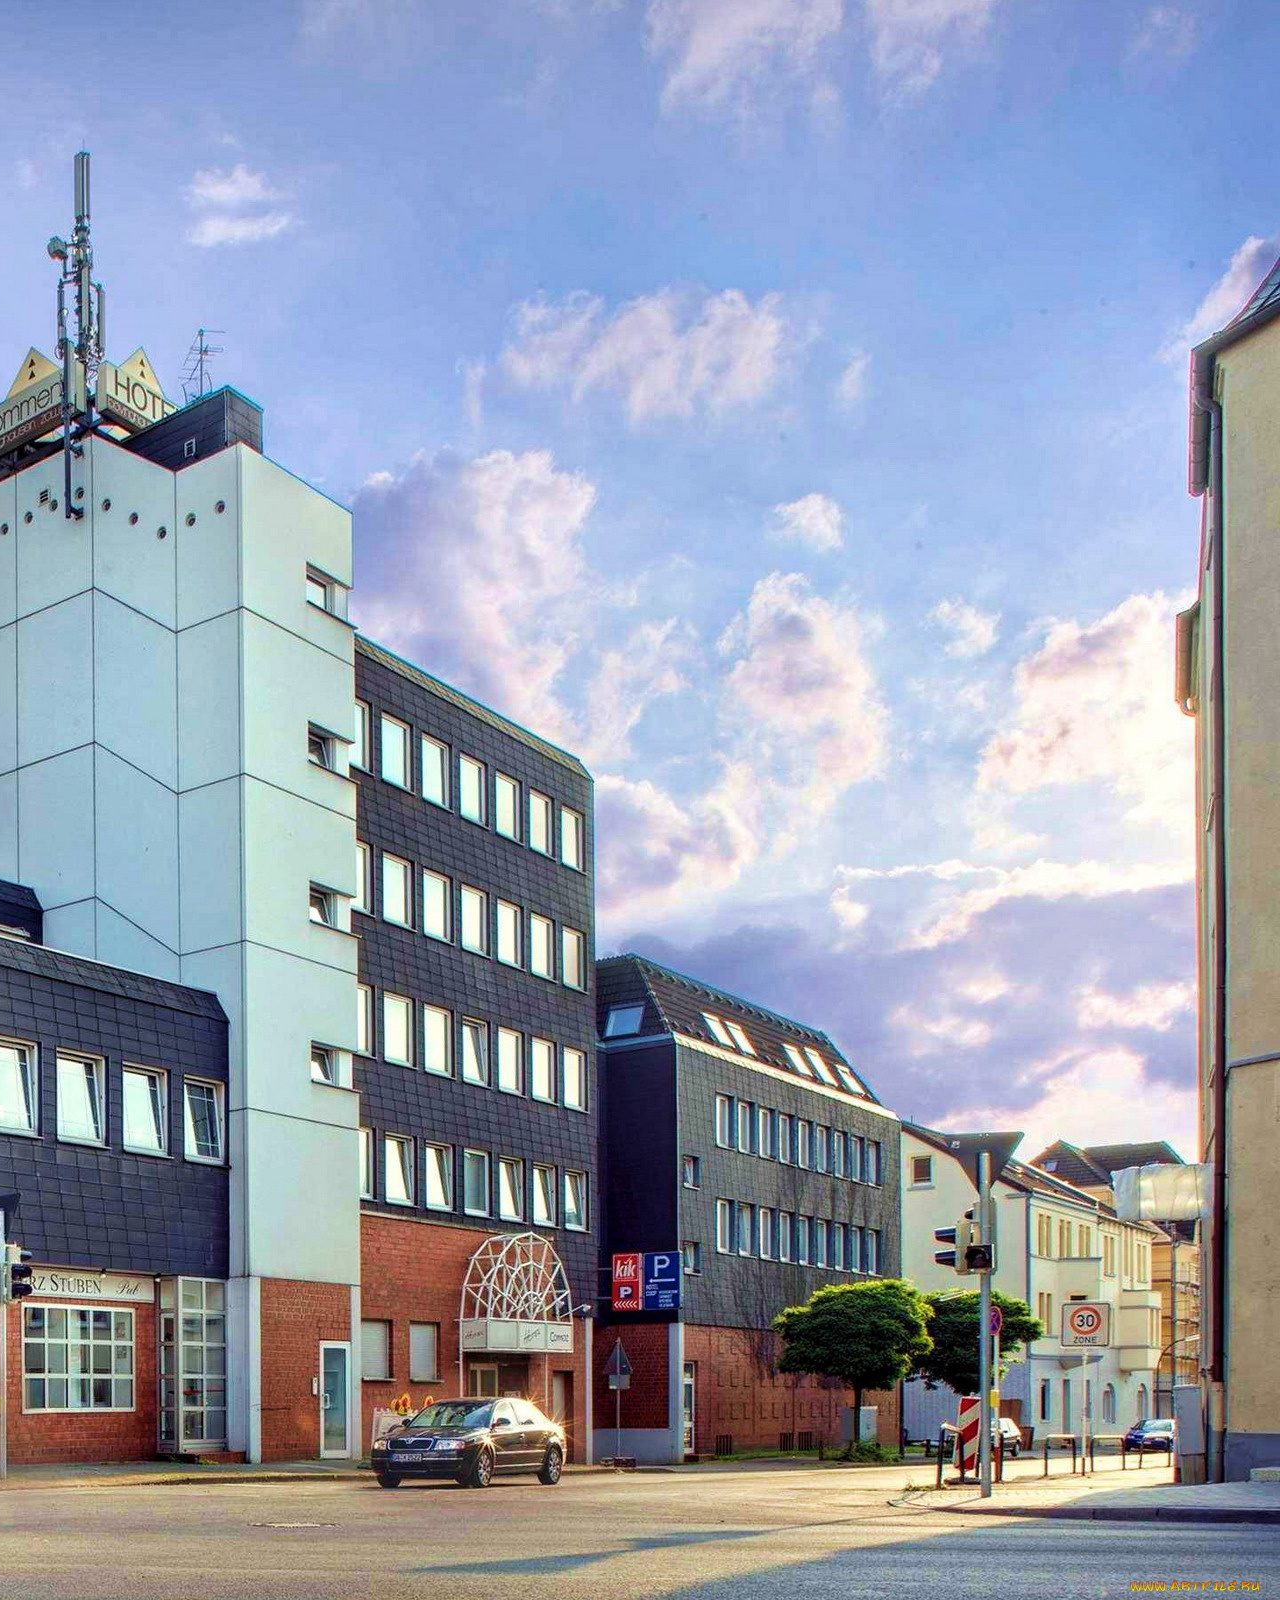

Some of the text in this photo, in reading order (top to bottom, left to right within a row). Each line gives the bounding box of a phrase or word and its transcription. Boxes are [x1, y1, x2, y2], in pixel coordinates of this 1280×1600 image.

[114, 369, 178, 421] HOTE
[616, 1257, 636, 1277] kik
[115, 1280, 141, 1296] Pub
[1076, 1314, 1095, 1328] 30
[1073, 1336, 1097, 1344] ZONE
